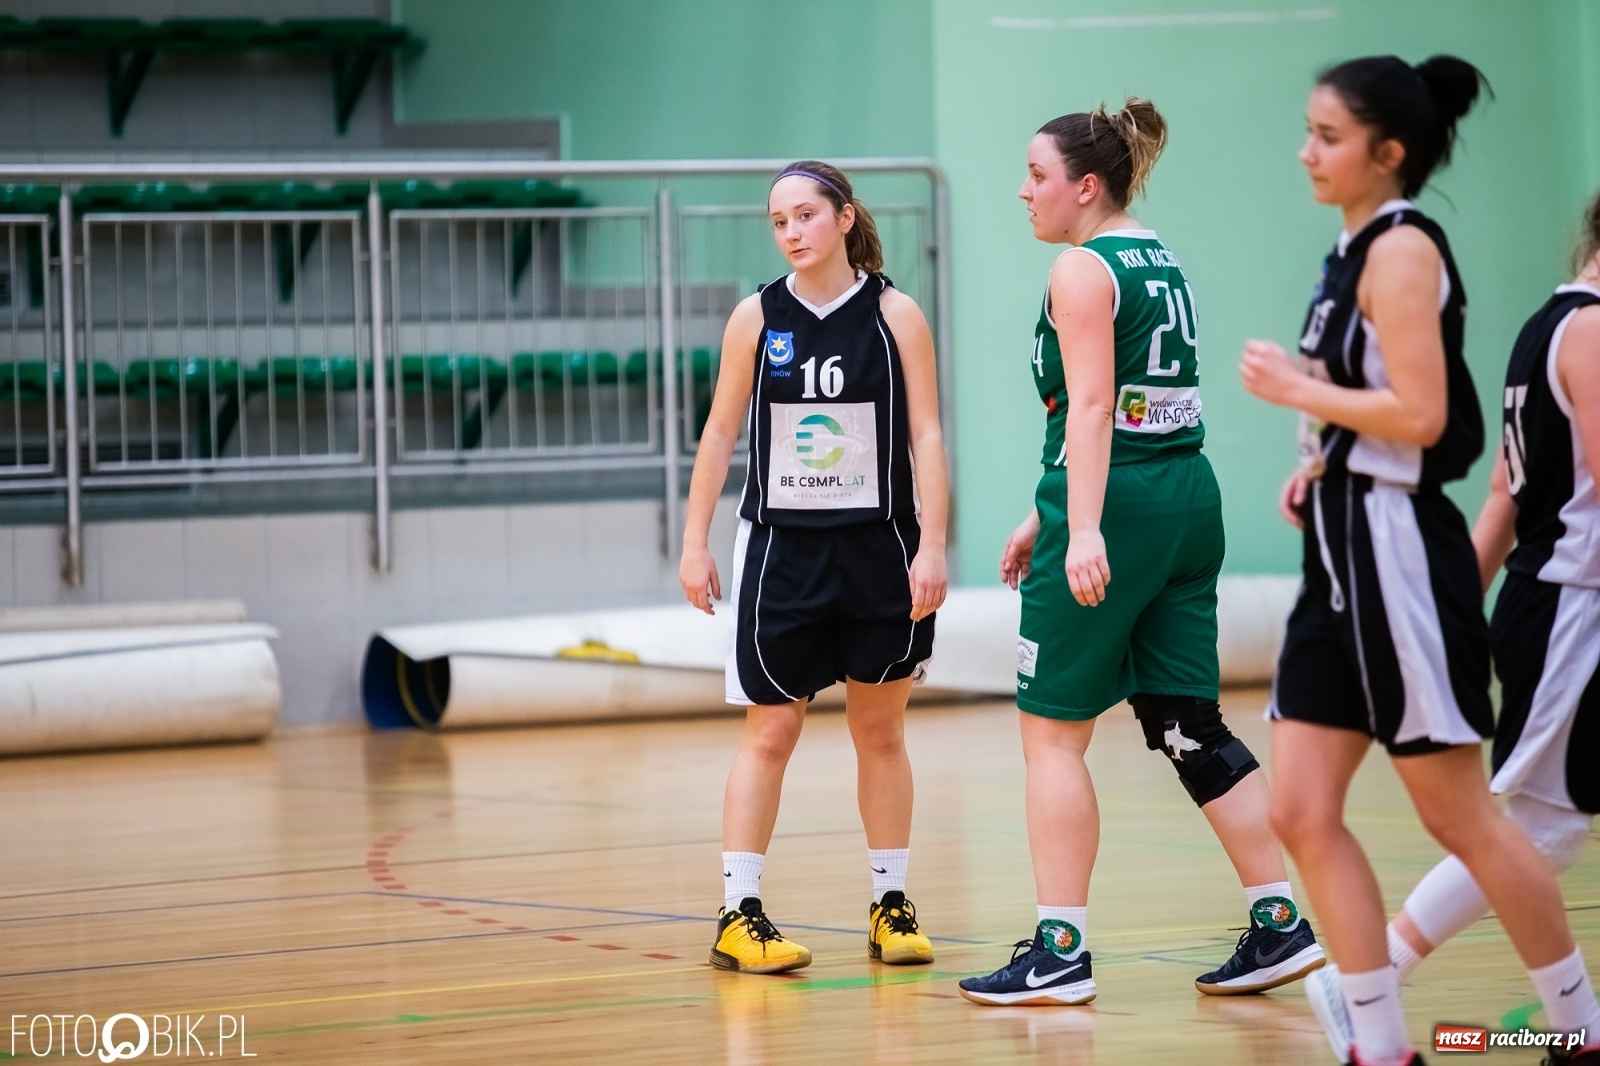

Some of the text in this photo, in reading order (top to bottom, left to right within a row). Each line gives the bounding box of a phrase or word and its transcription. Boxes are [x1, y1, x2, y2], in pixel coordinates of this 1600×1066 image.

[1115, 248, 1149, 269] RKK
[1145, 279, 1199, 377] 24
[800, 355, 845, 399] 16
[780, 475, 866, 488] BE COMPLEAT
